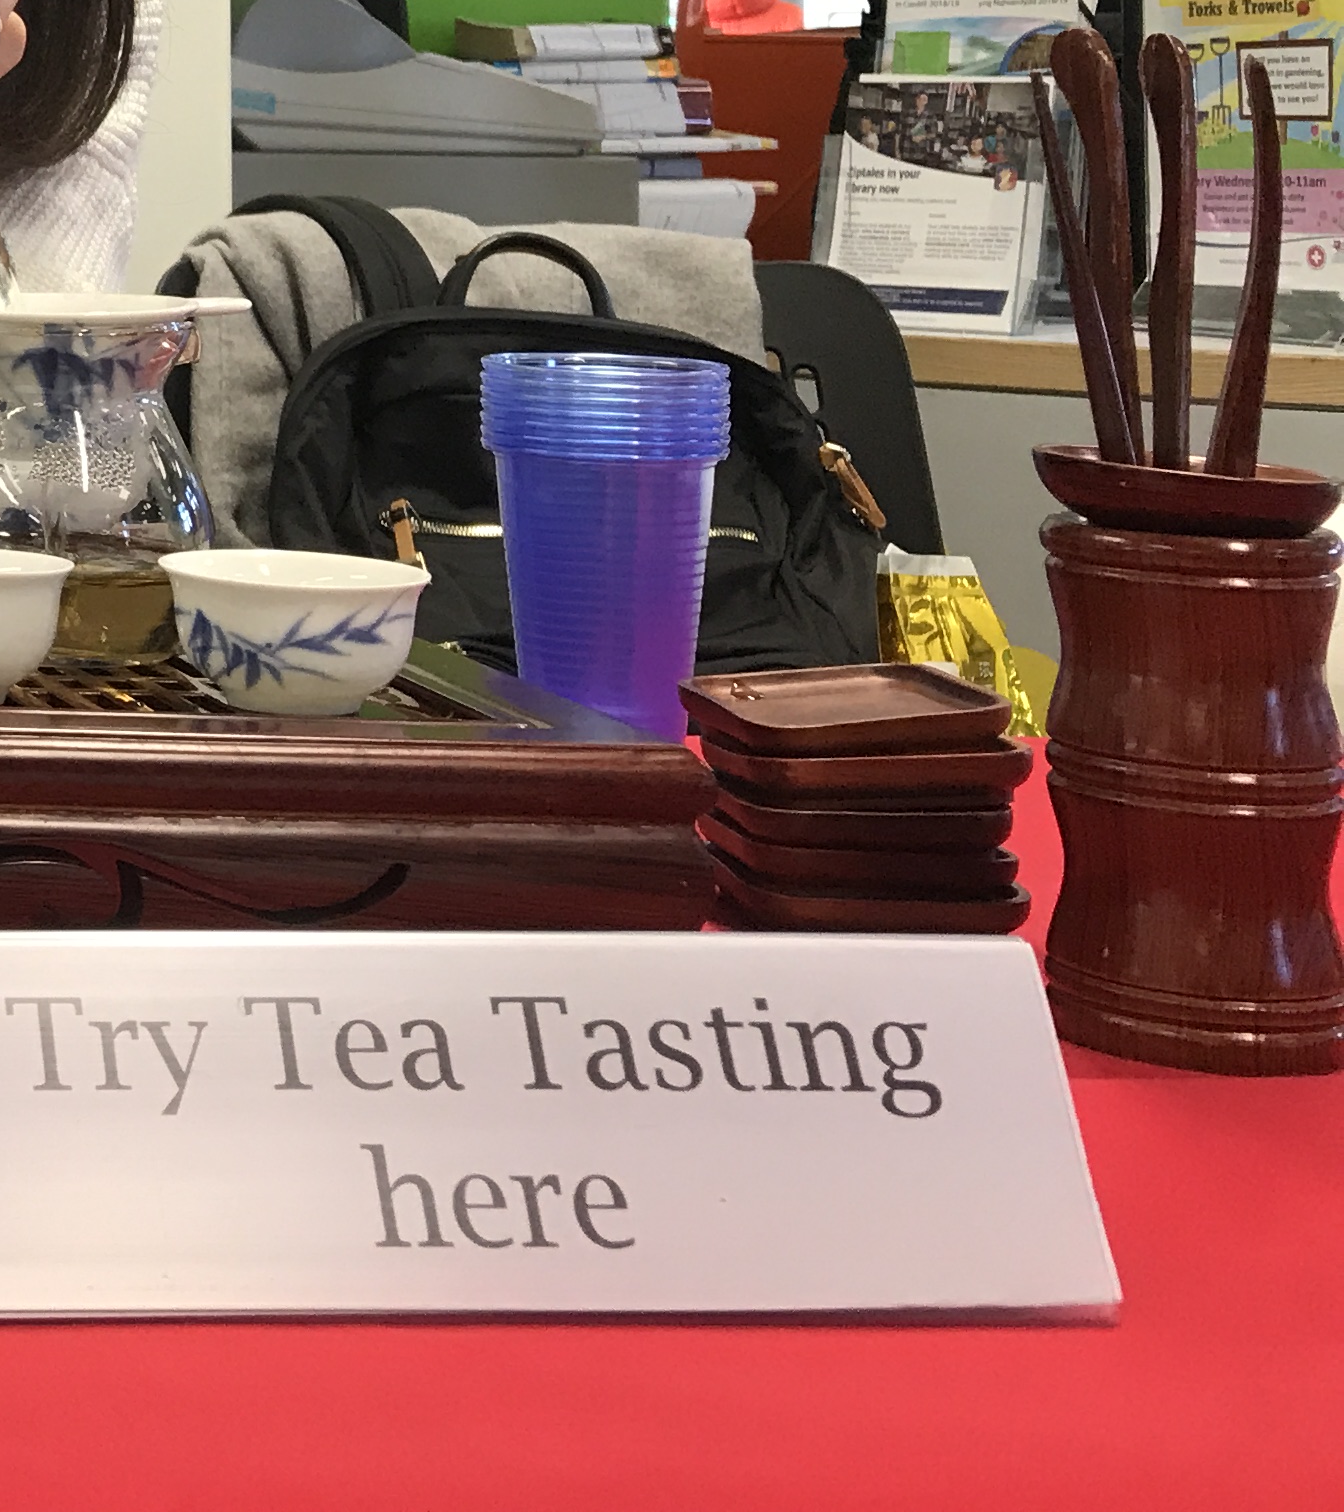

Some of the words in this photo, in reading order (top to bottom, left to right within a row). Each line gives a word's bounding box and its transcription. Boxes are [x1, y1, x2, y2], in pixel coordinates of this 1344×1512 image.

[1188, 0, 1223, 18] Forks
[1228, 0, 1238, 15] &
[4, 997, 209, 1116] Try
[242, 997, 466, 1092] Tea
[490, 996, 944, 1119] Tasting
[359, 1143, 637, 1250] here
